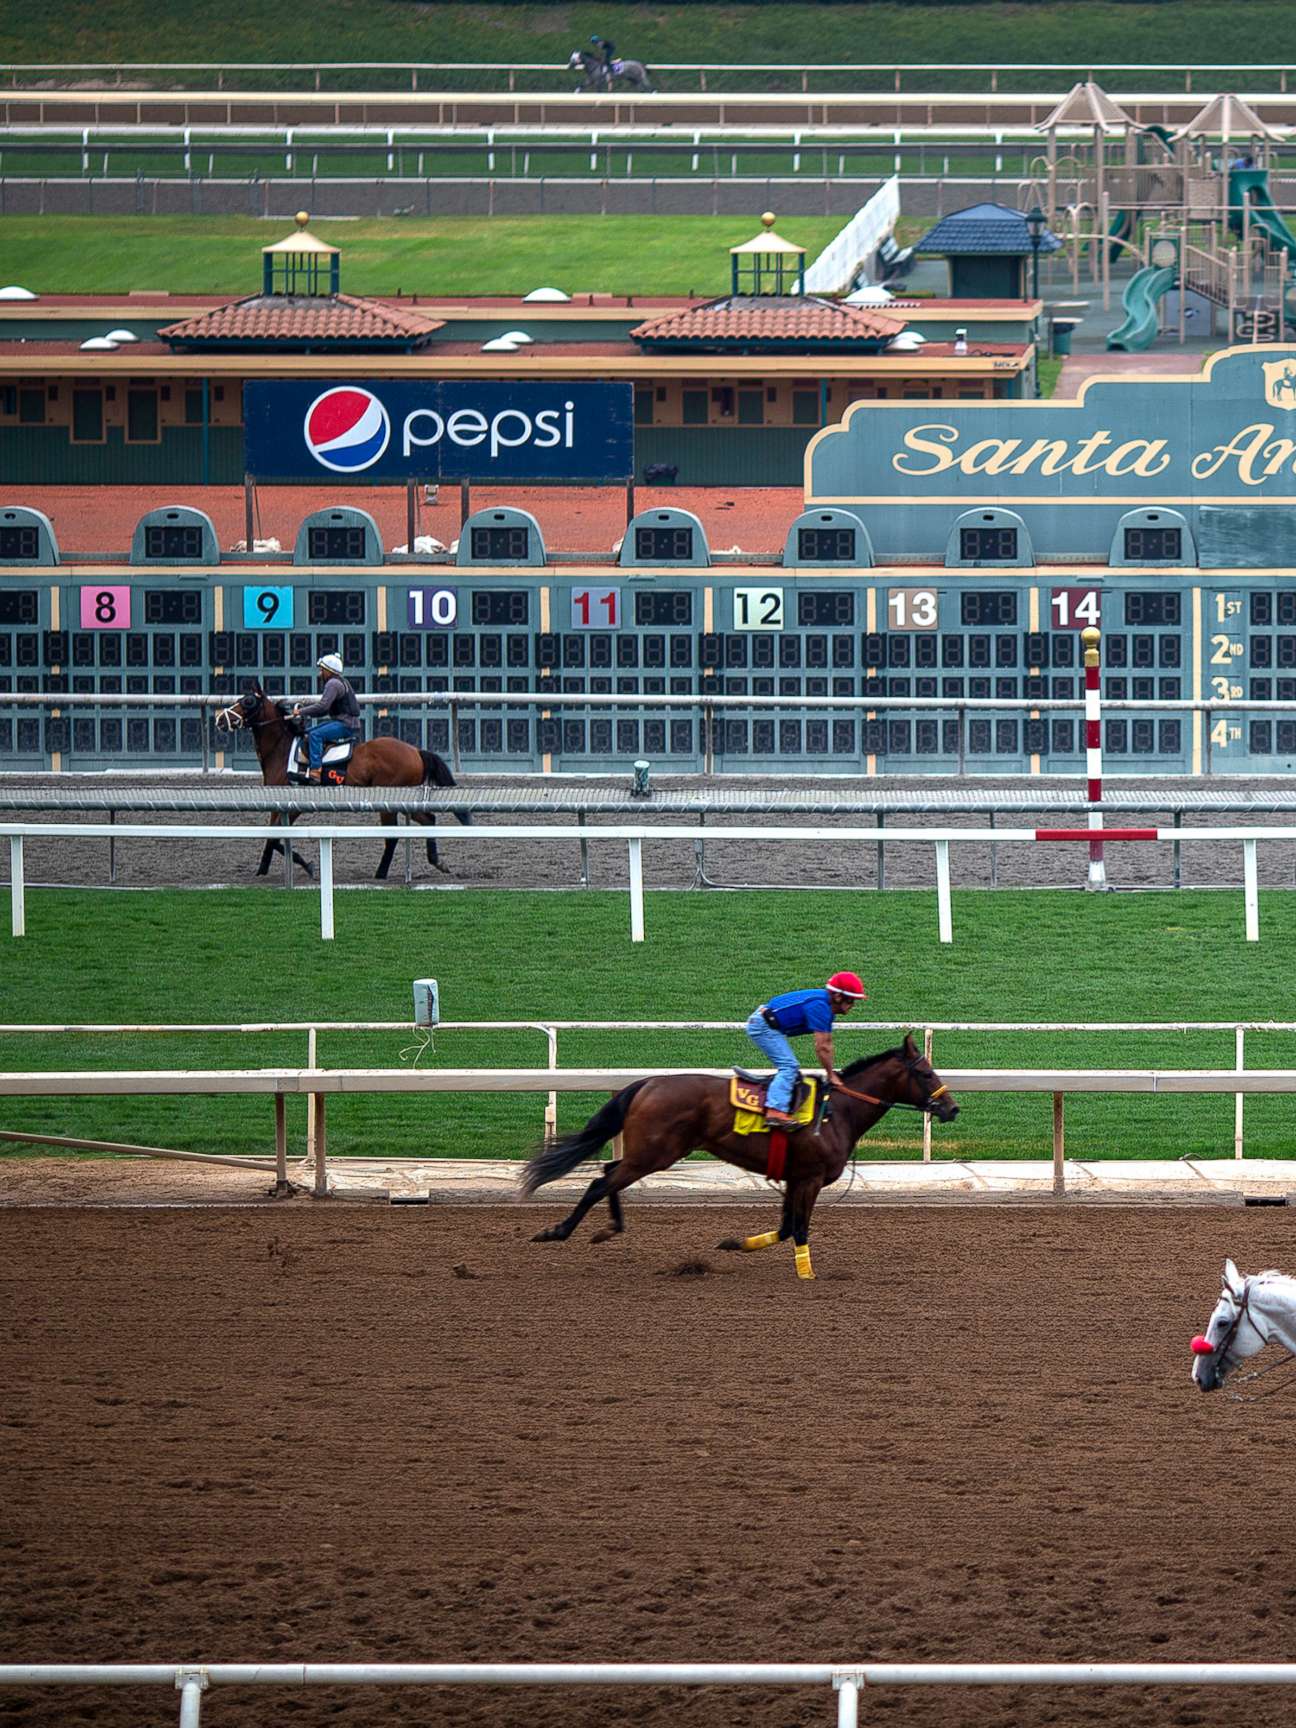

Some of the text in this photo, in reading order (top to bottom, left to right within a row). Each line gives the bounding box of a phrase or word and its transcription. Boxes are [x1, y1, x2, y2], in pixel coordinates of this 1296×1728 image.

[403, 402, 574, 457] pepsi
[892, 424, 1169, 477] Santa
[95, 591, 116, 624] 8
[257, 592, 279, 624] 9
[409, 590, 457, 625] 10
[574, 592, 616, 625] 11
[736, 592, 782, 625] 12
[888, 591, 938, 627] 13
[1051, 591, 1101, 626] 14
